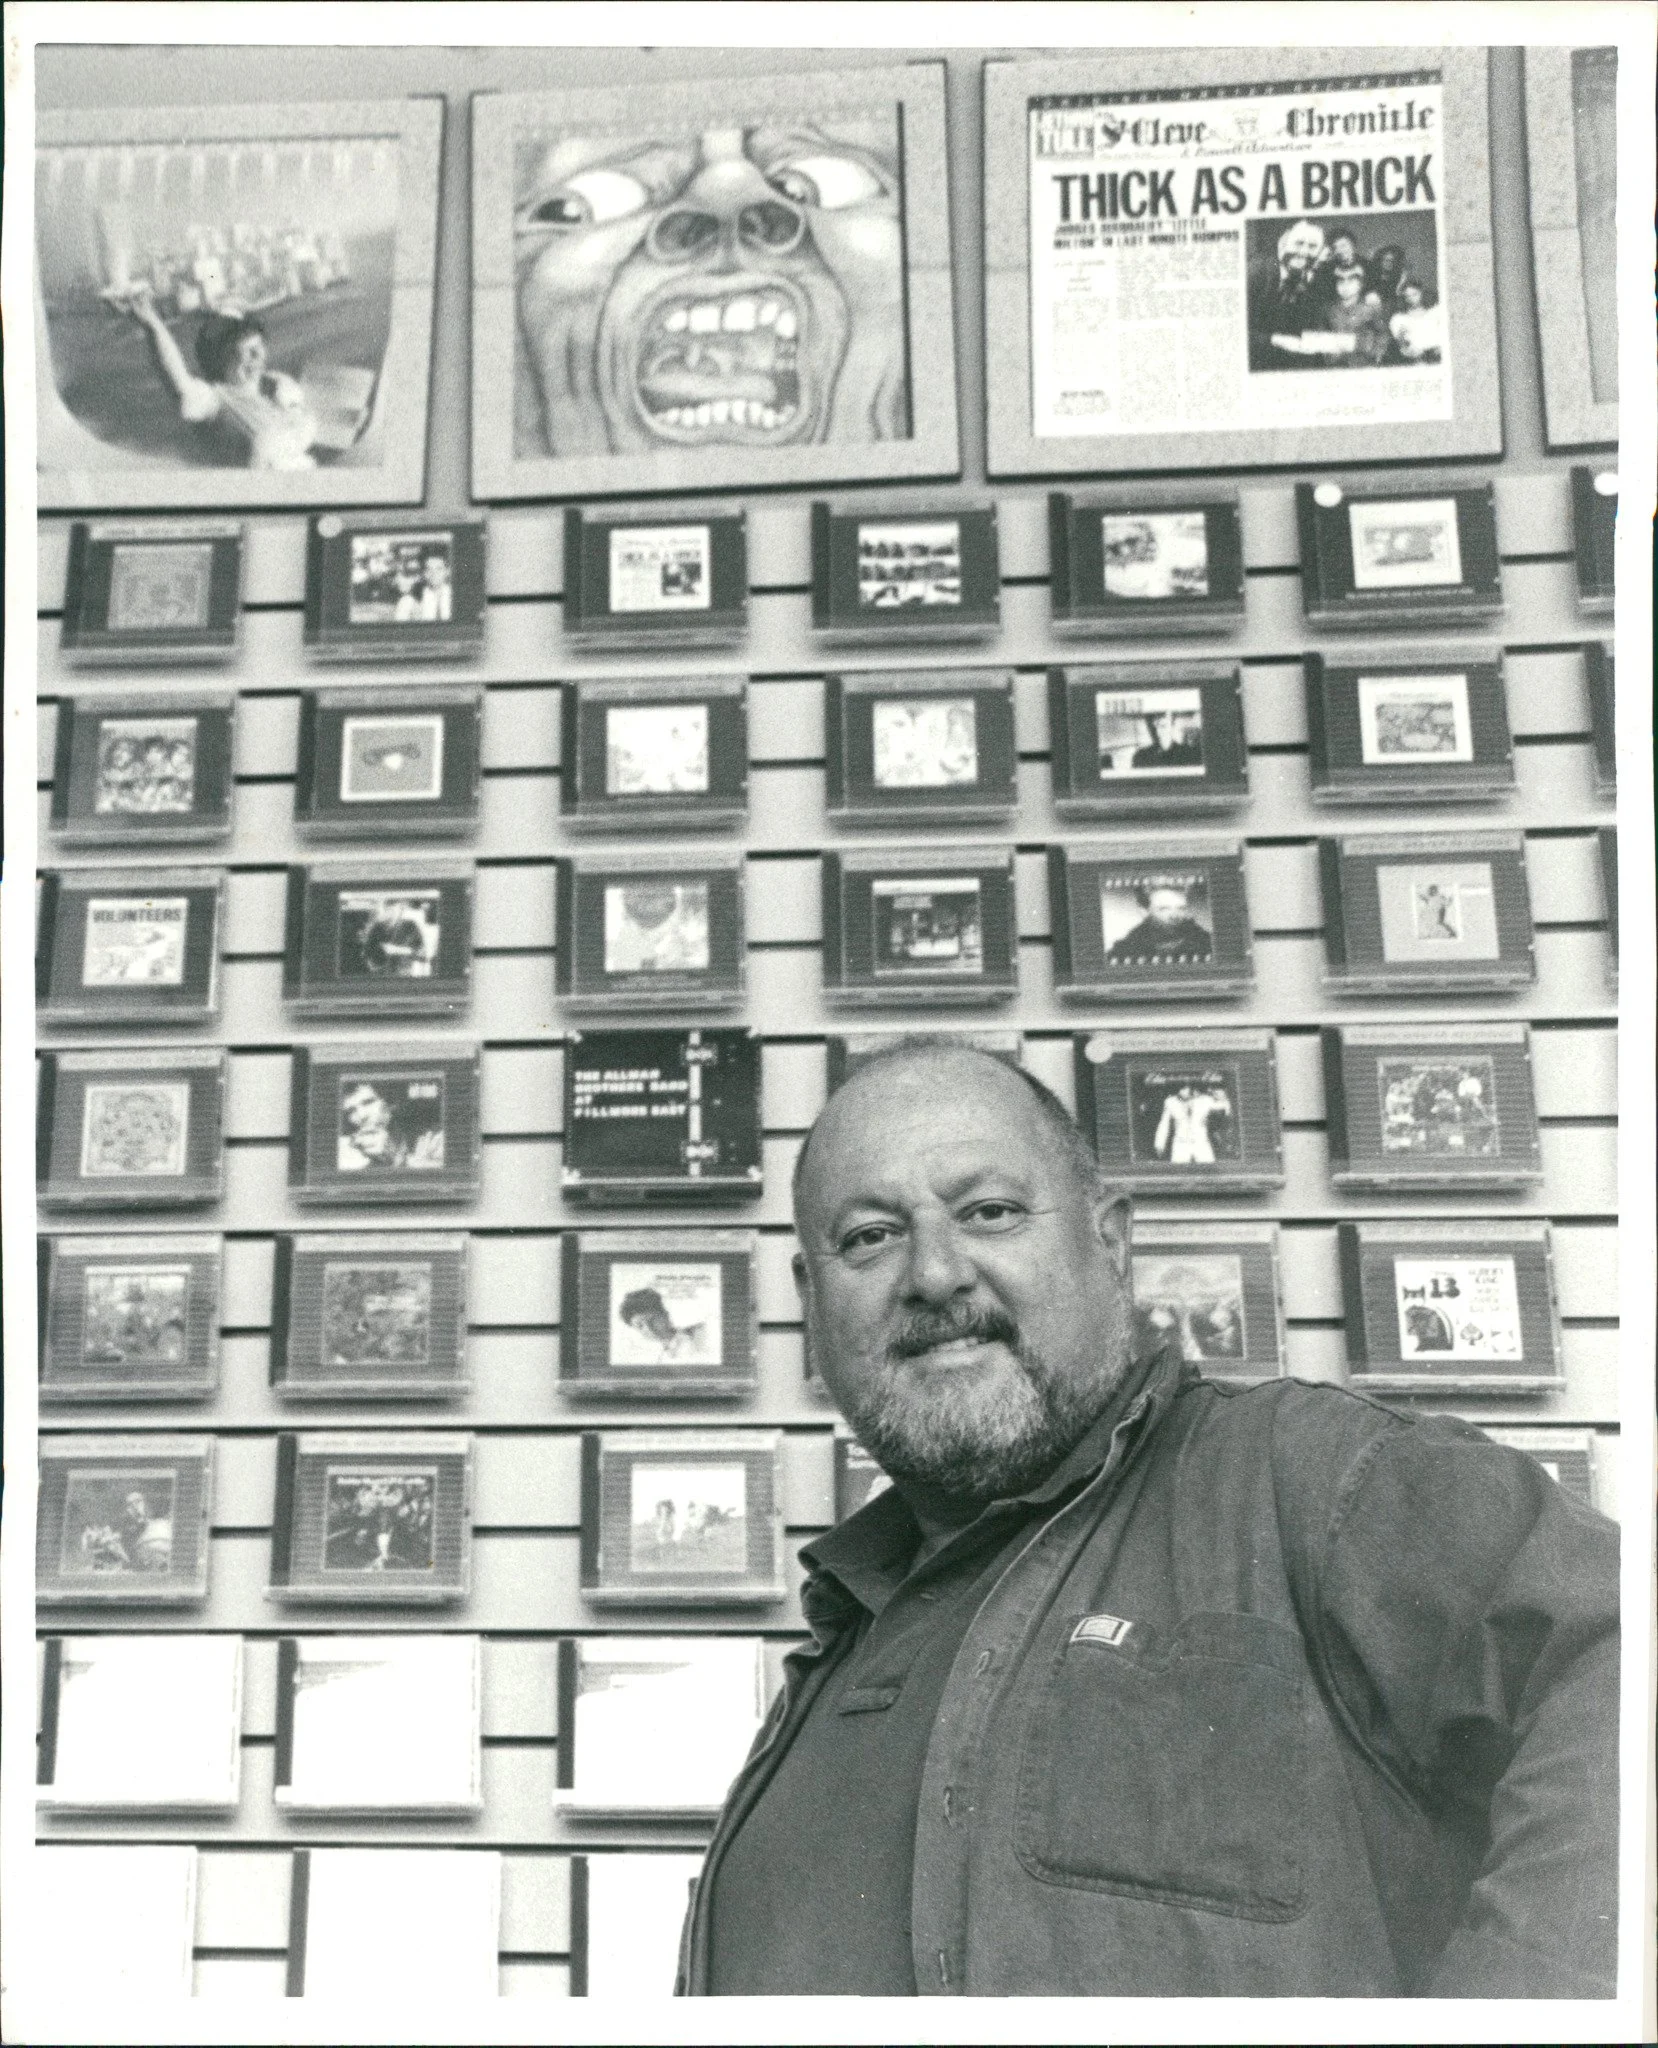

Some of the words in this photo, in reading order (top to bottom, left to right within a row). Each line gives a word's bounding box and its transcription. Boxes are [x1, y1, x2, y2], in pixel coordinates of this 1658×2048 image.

[1131, 118, 1206, 146] Cleve
[1286, 100, 1435, 137] Chronicle
[1052, 169, 1178, 221] THICK
[1191, 165, 1247, 216] AS
[1258, 163, 1288, 212] A
[1302, 153, 1436, 210] BRICK
[92, 908, 182, 923] VOLUNTEERS
[574, 1070, 600, 1081] THE
[604, 1068, 660, 1081] ALLMAN
[574, 1081, 644, 1094] BROTHERS
[649, 1080, 688, 1092] BAND
[574, 1094, 593, 1106] AT
[574, 1106, 647, 1117] FILLMORE
[651, 1104, 686, 1116] EAST
[1430, 1277, 1461, 1299] 13
